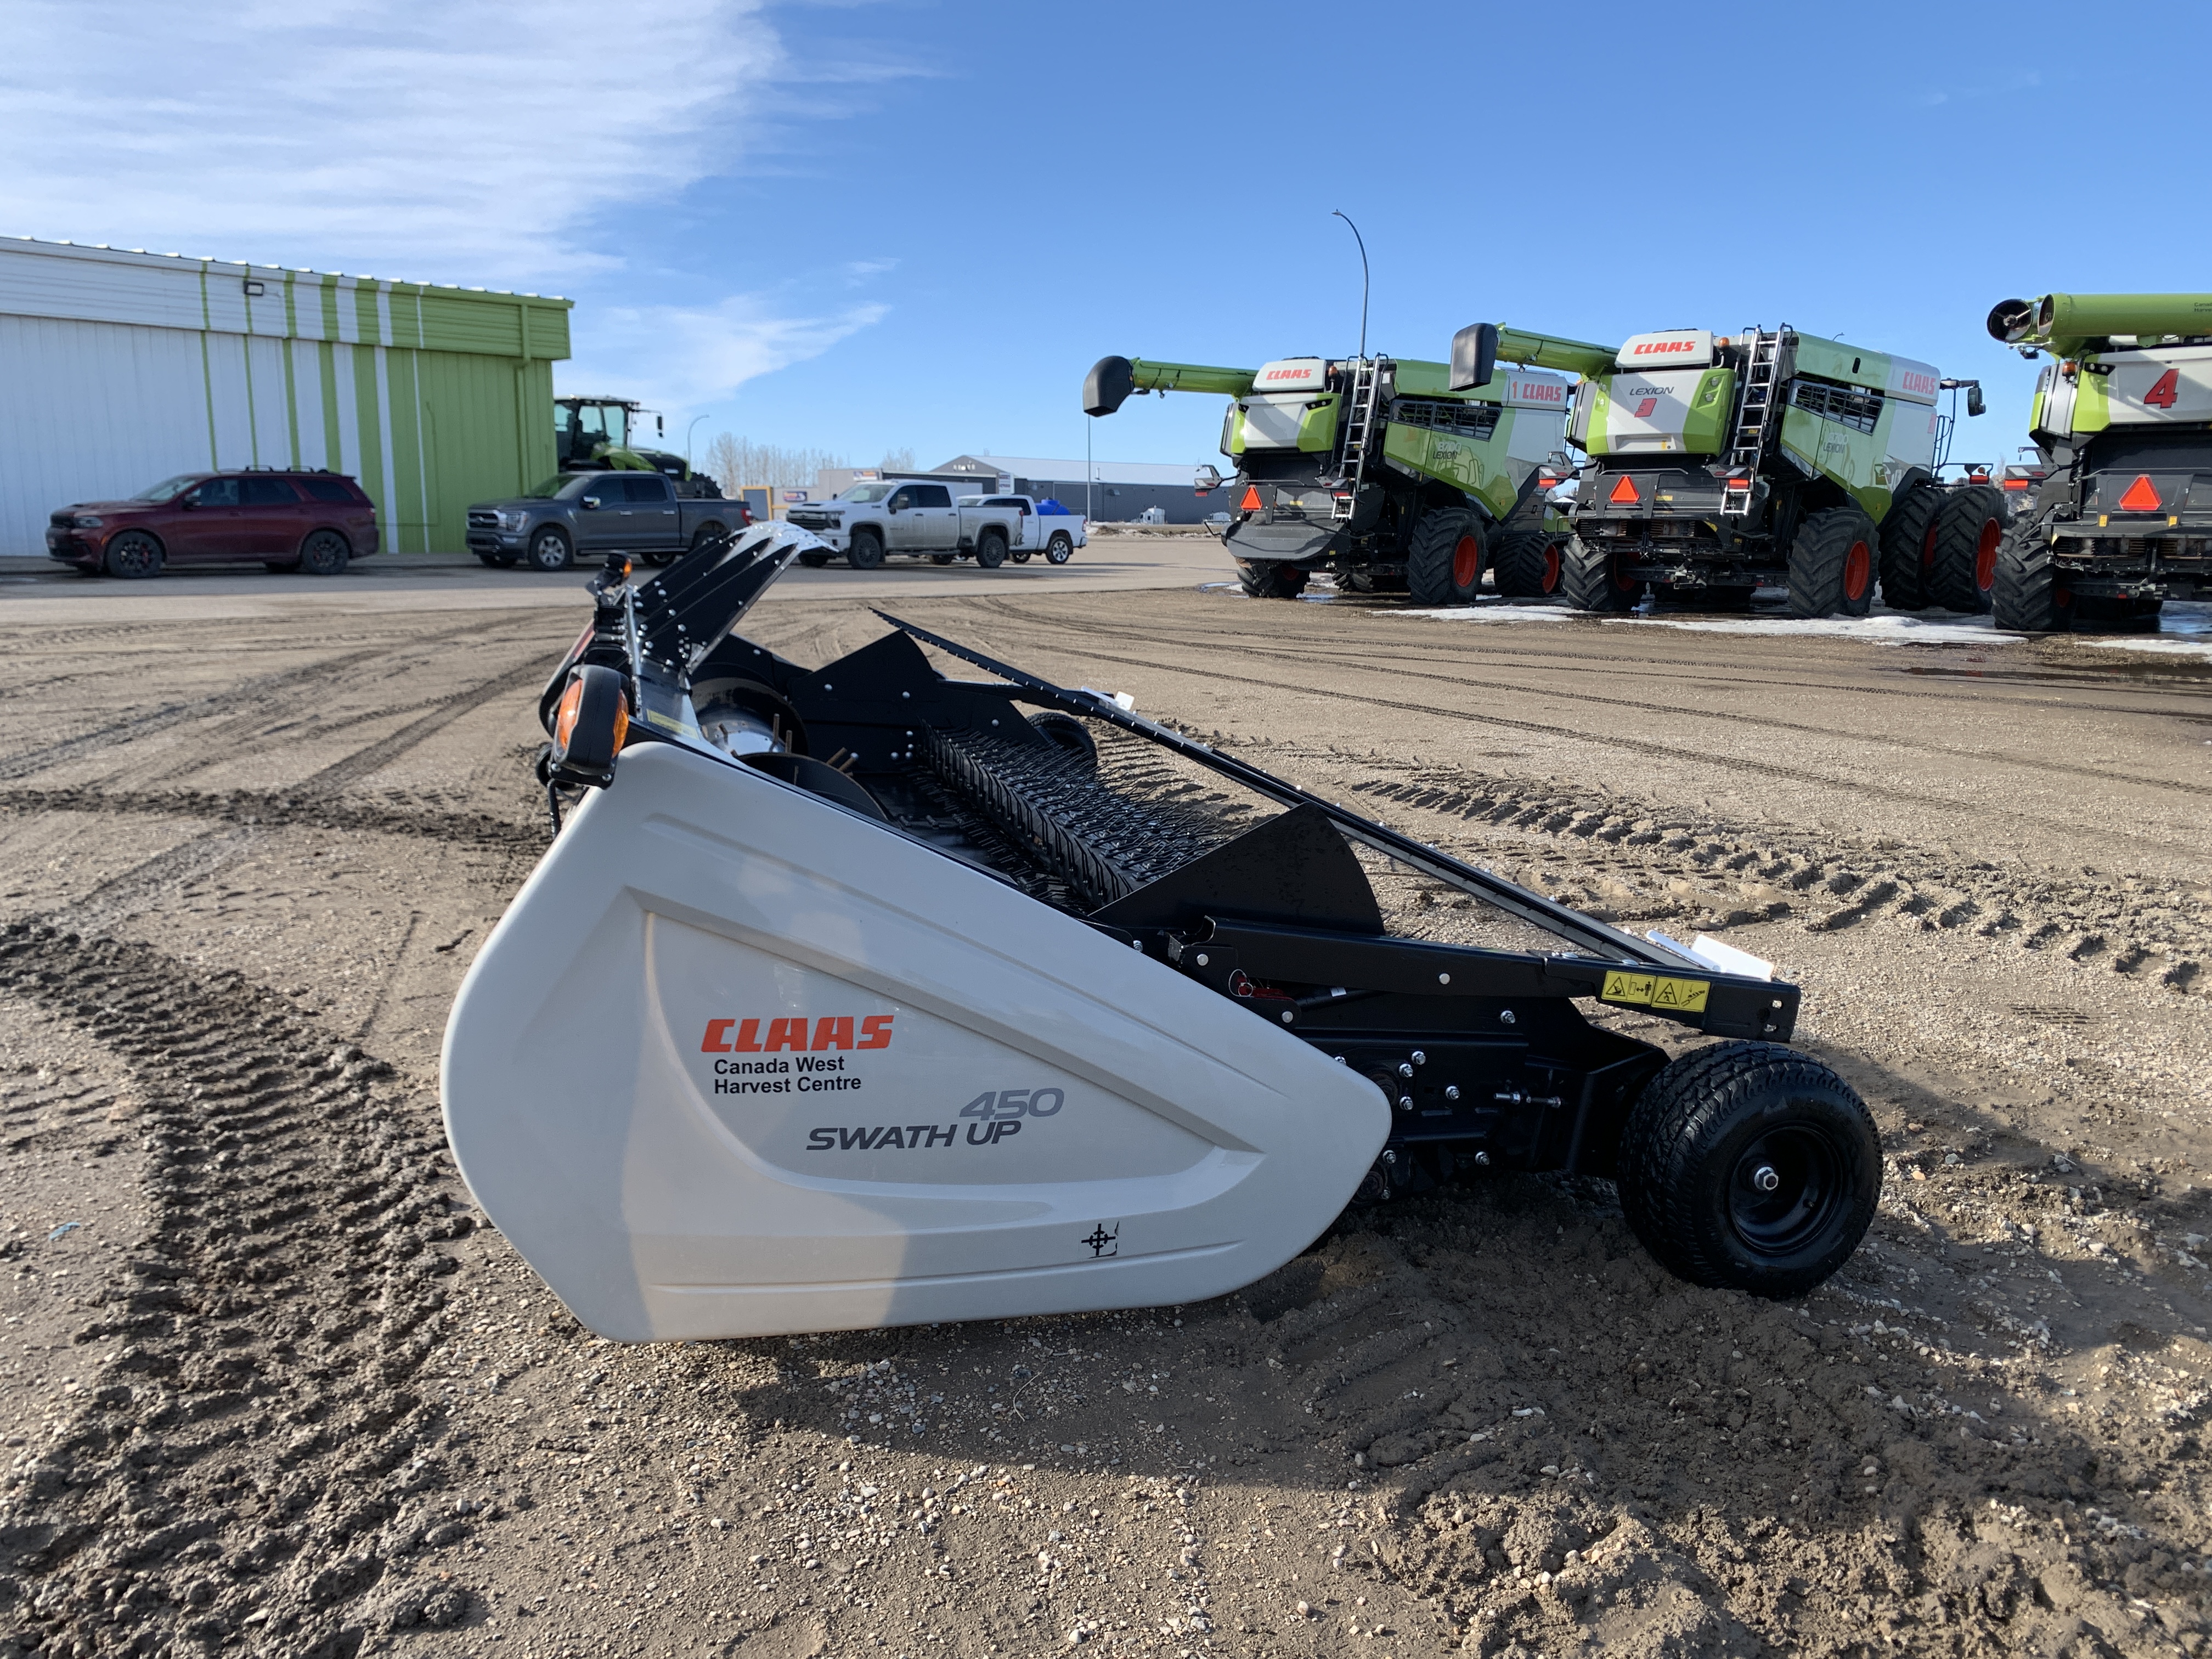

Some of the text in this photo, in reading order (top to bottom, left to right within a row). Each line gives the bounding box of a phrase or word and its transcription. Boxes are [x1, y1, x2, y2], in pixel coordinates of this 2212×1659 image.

[1633, 341, 1696, 354] CLAAS
[1266, 369, 1312, 380] CLAAS
[1903, 371, 1936, 395] CLAAS
[1522, 383, 1562, 402] CLAAS
[1629, 387, 1674, 396] LEXION
[2143, 368, 2180, 409] 4
[1634, 398, 1657, 417] 3
[1432, 451, 1458, 460] LEXION
[1437, 442, 1462, 452] 8700
[701, 1015, 894, 1052] CLAAS
[714, 1056, 844, 1074] Canada West
[714, 1075, 861, 1094] Harvest Centre
[959, 1087, 1065, 1121] 450
[806, 1120, 1022, 1150] SWATH UP
